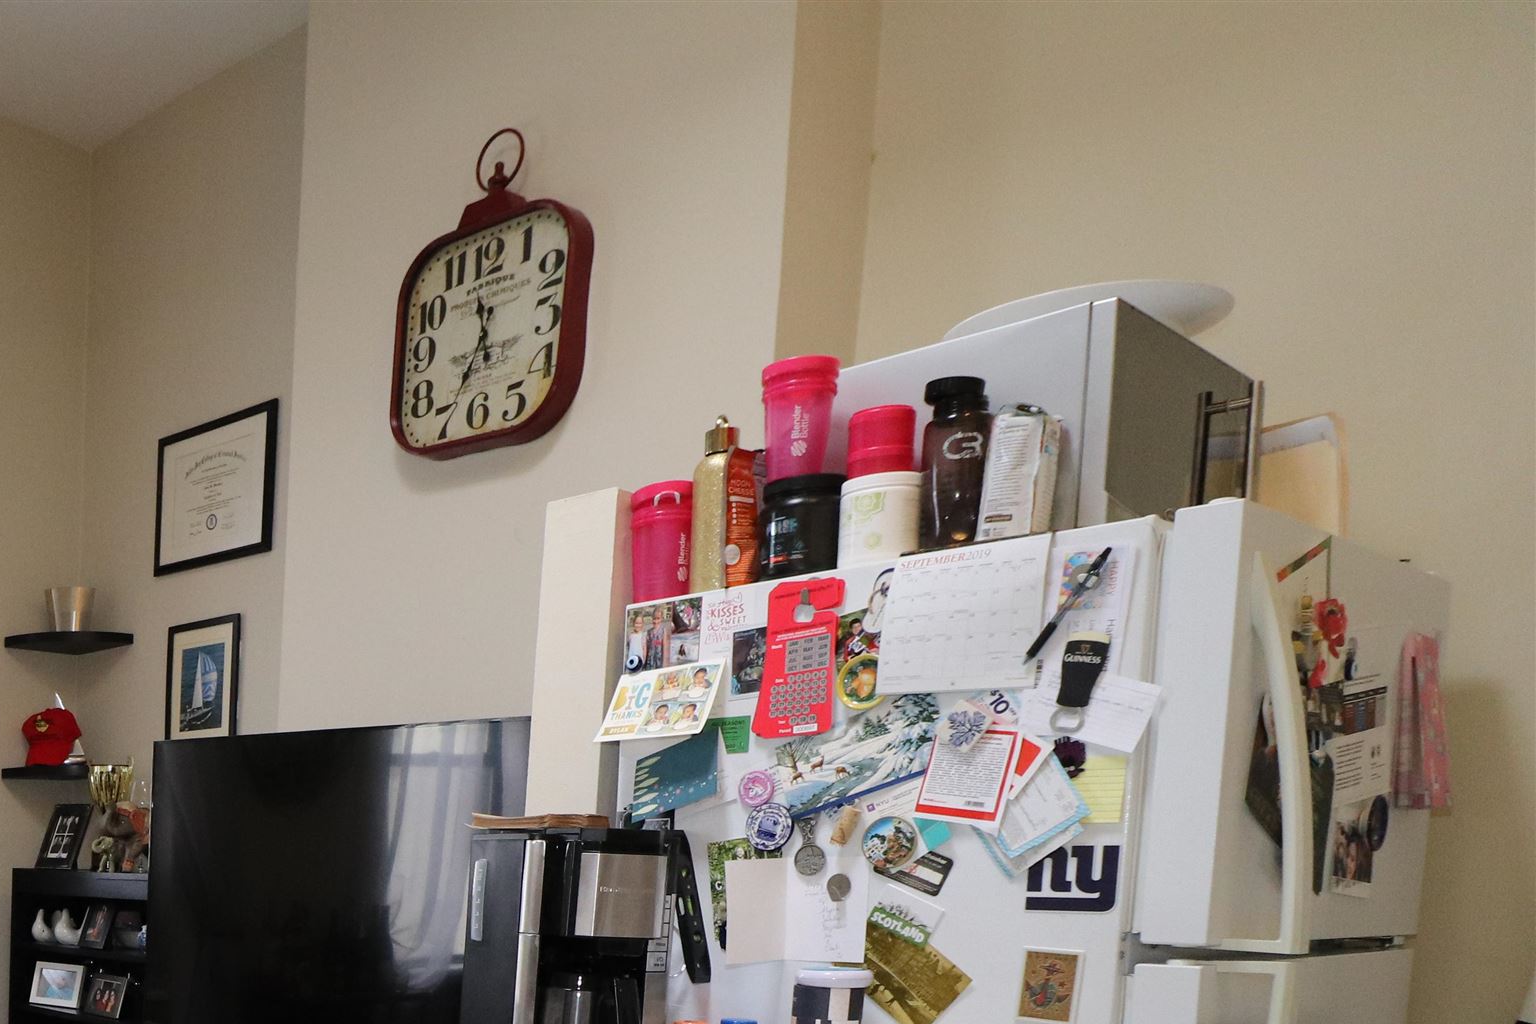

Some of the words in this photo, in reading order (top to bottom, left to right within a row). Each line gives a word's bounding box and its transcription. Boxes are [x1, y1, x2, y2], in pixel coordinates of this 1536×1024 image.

[473, 237, 505, 282] 12
[521, 225, 533, 264] 1
[444, 251, 466, 292] 11
[537, 249, 565, 291] 2
[418, 295, 447, 336] 10
[534, 292, 561, 335] 3
[414, 336, 436, 373] 9
[528, 341, 557, 379] 4
[411, 380, 434, 419] 8
[466, 392, 489, 429] 6
[502, 380, 527, 422] 5
[435, 402, 458, 440] 7
[791, 405, 802, 440] Blender
[800, 412, 810, 439] Bottle
[678, 532, 687, 566] Blender
[900, 552, 965, 570] SEPTEMBER
[965, 549, 992, 561] 2019
[710, 603, 744, 618] KISSES
[1064, 653, 1102, 664] GUINNESS
[610, 710, 644, 721] THANKS
[989, 689, 1010, 714] $10
[1025, 845, 1120, 912] ny
[870, 911, 925, 943] SCOTLAND
